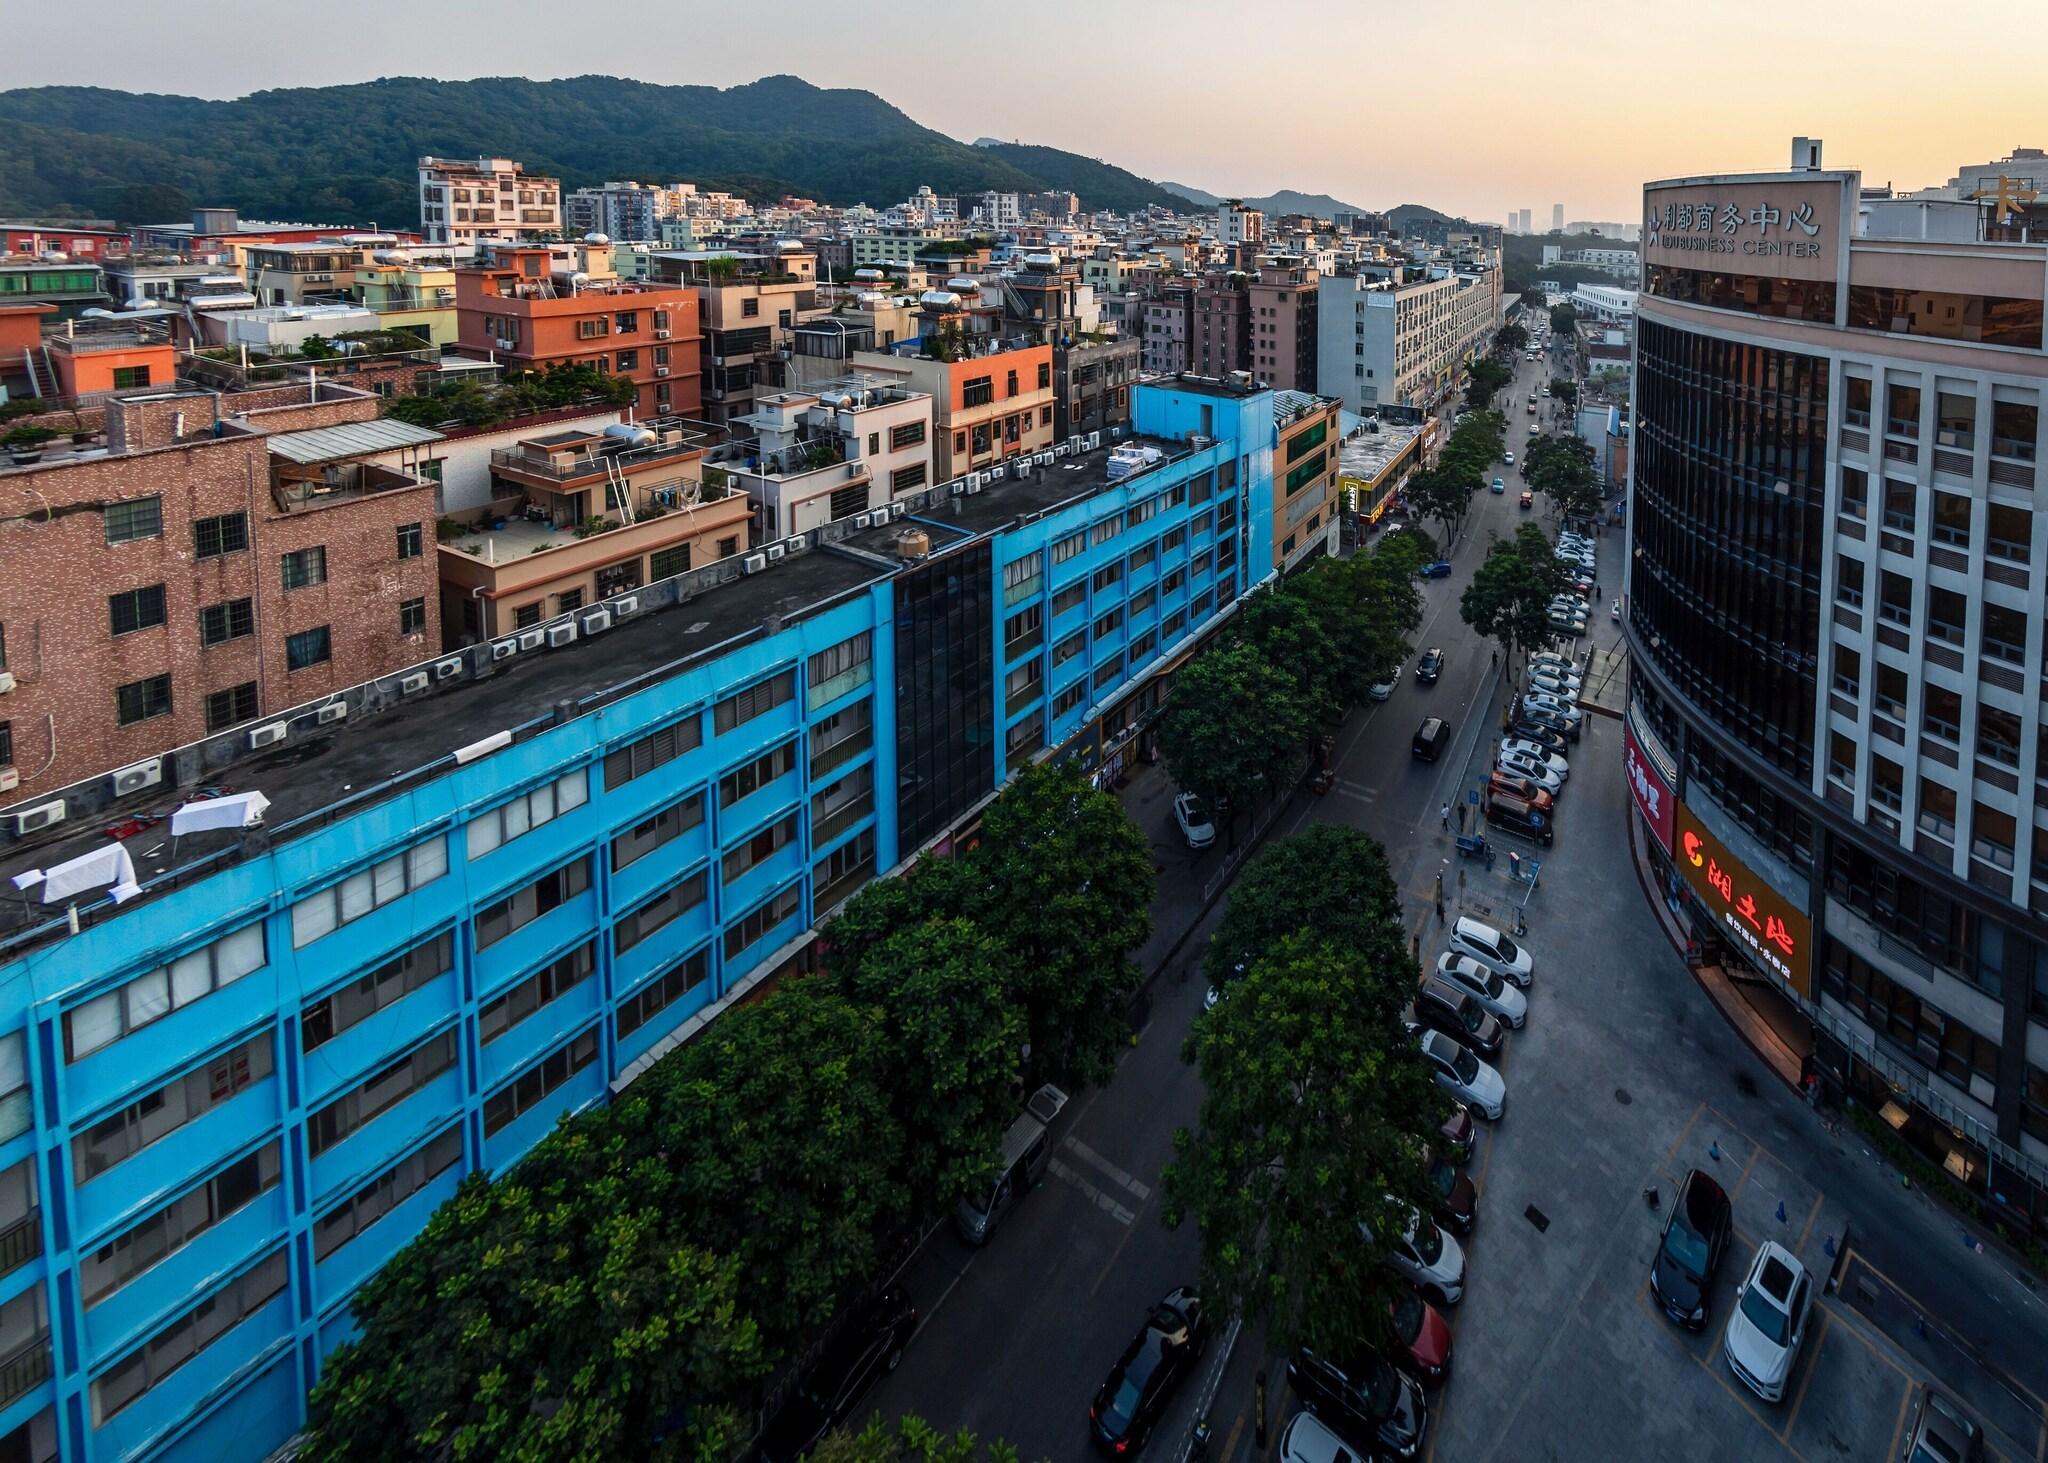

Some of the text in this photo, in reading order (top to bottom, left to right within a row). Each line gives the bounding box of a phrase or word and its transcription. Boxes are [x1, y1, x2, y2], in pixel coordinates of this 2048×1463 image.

[1664, 202, 1820, 236] 利都商务中心
[1743, 240, 1821, 258] CENTER
